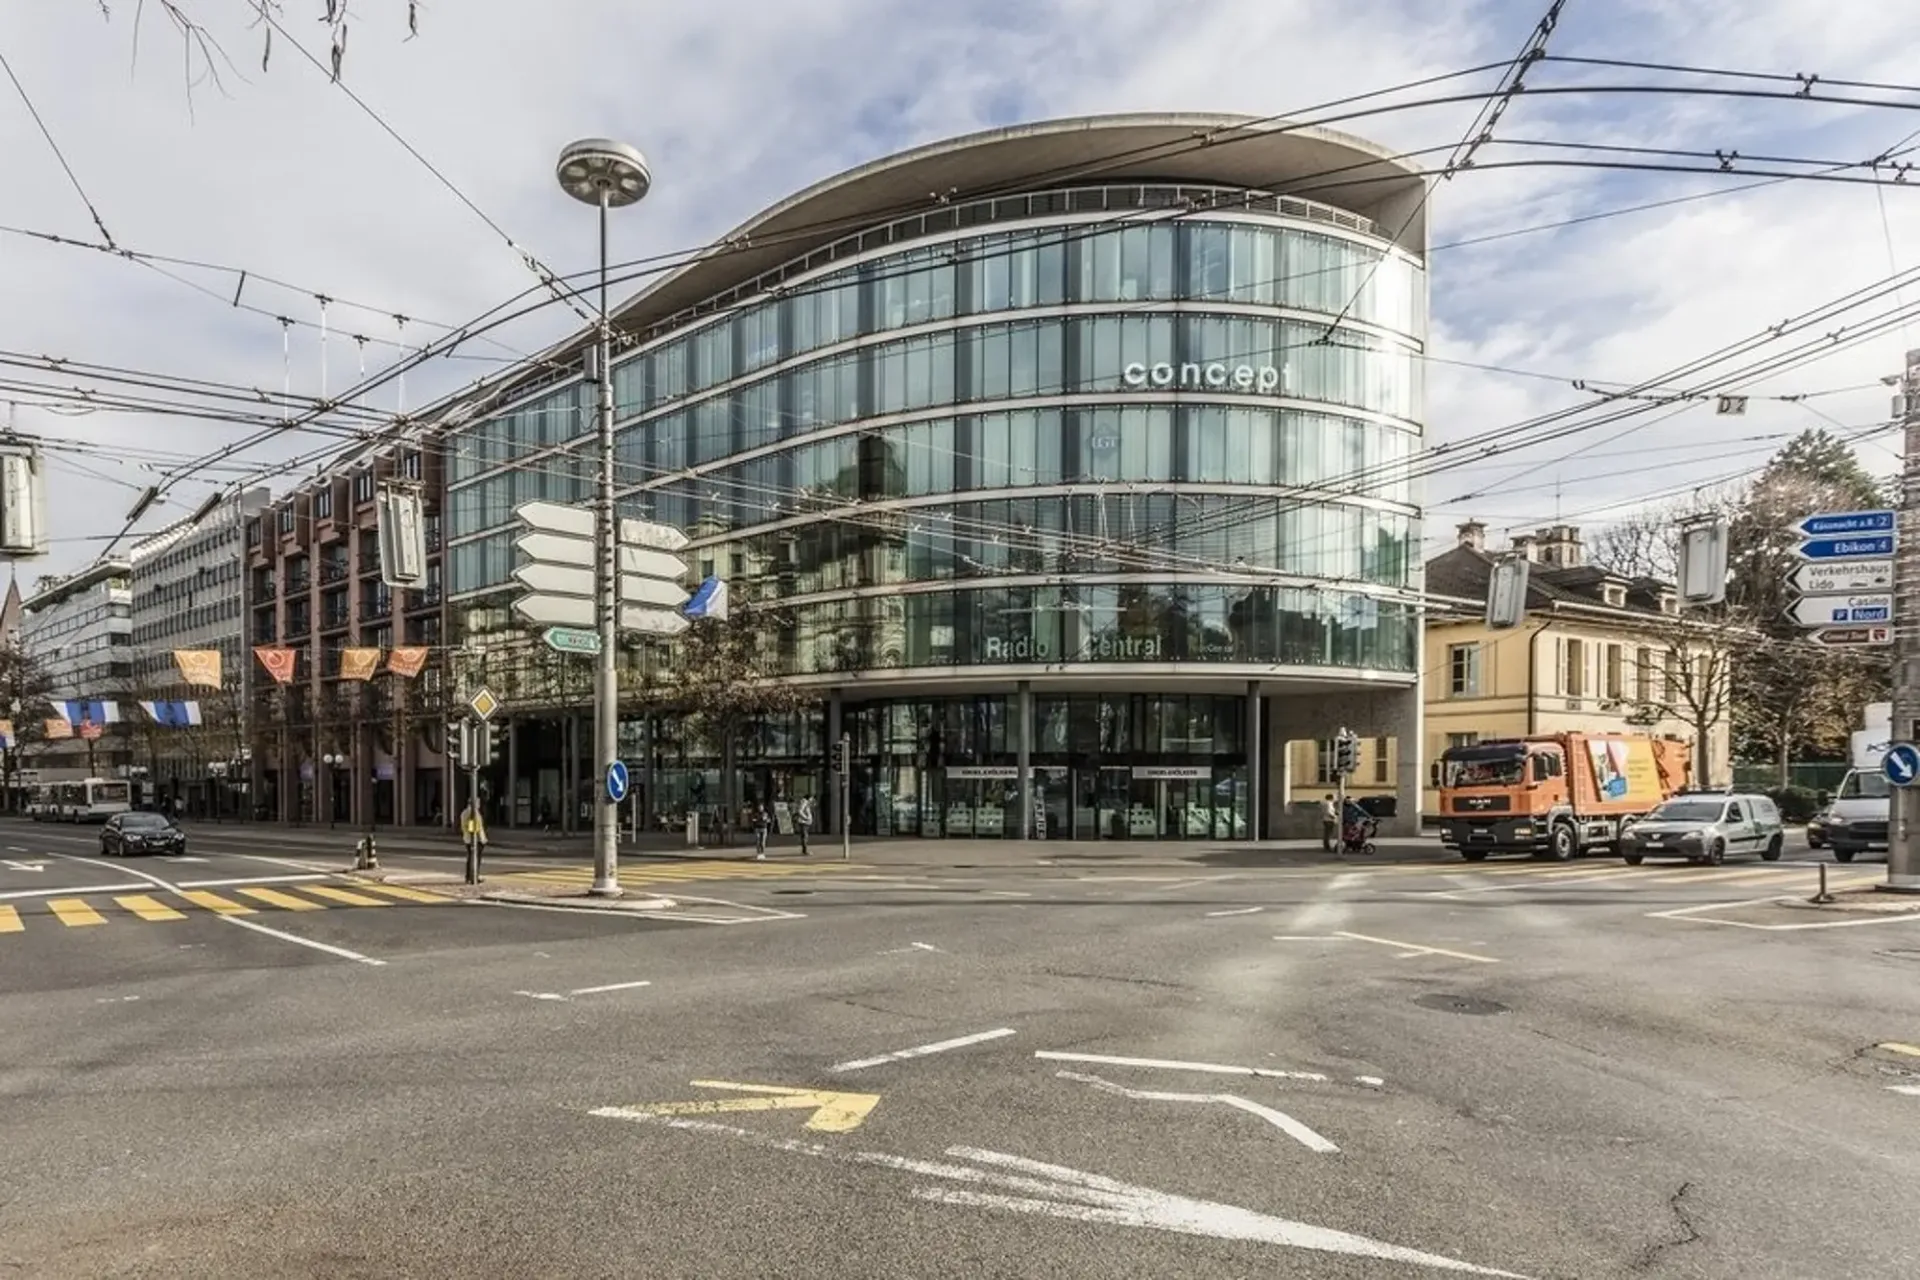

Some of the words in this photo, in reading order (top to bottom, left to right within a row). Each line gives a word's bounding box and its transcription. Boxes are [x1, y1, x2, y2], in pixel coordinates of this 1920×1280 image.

[1124, 361, 1292, 393] concept
[1834, 541, 1876, 553] Ebikon
[1808, 563, 1889, 577] Verkehrshaus
[1808, 579, 1835, 589] Lido
[1848, 597, 1888, 607] Casino
[1854, 608, 1885, 620] Nord
[986, 636, 1049, 658] Radio
